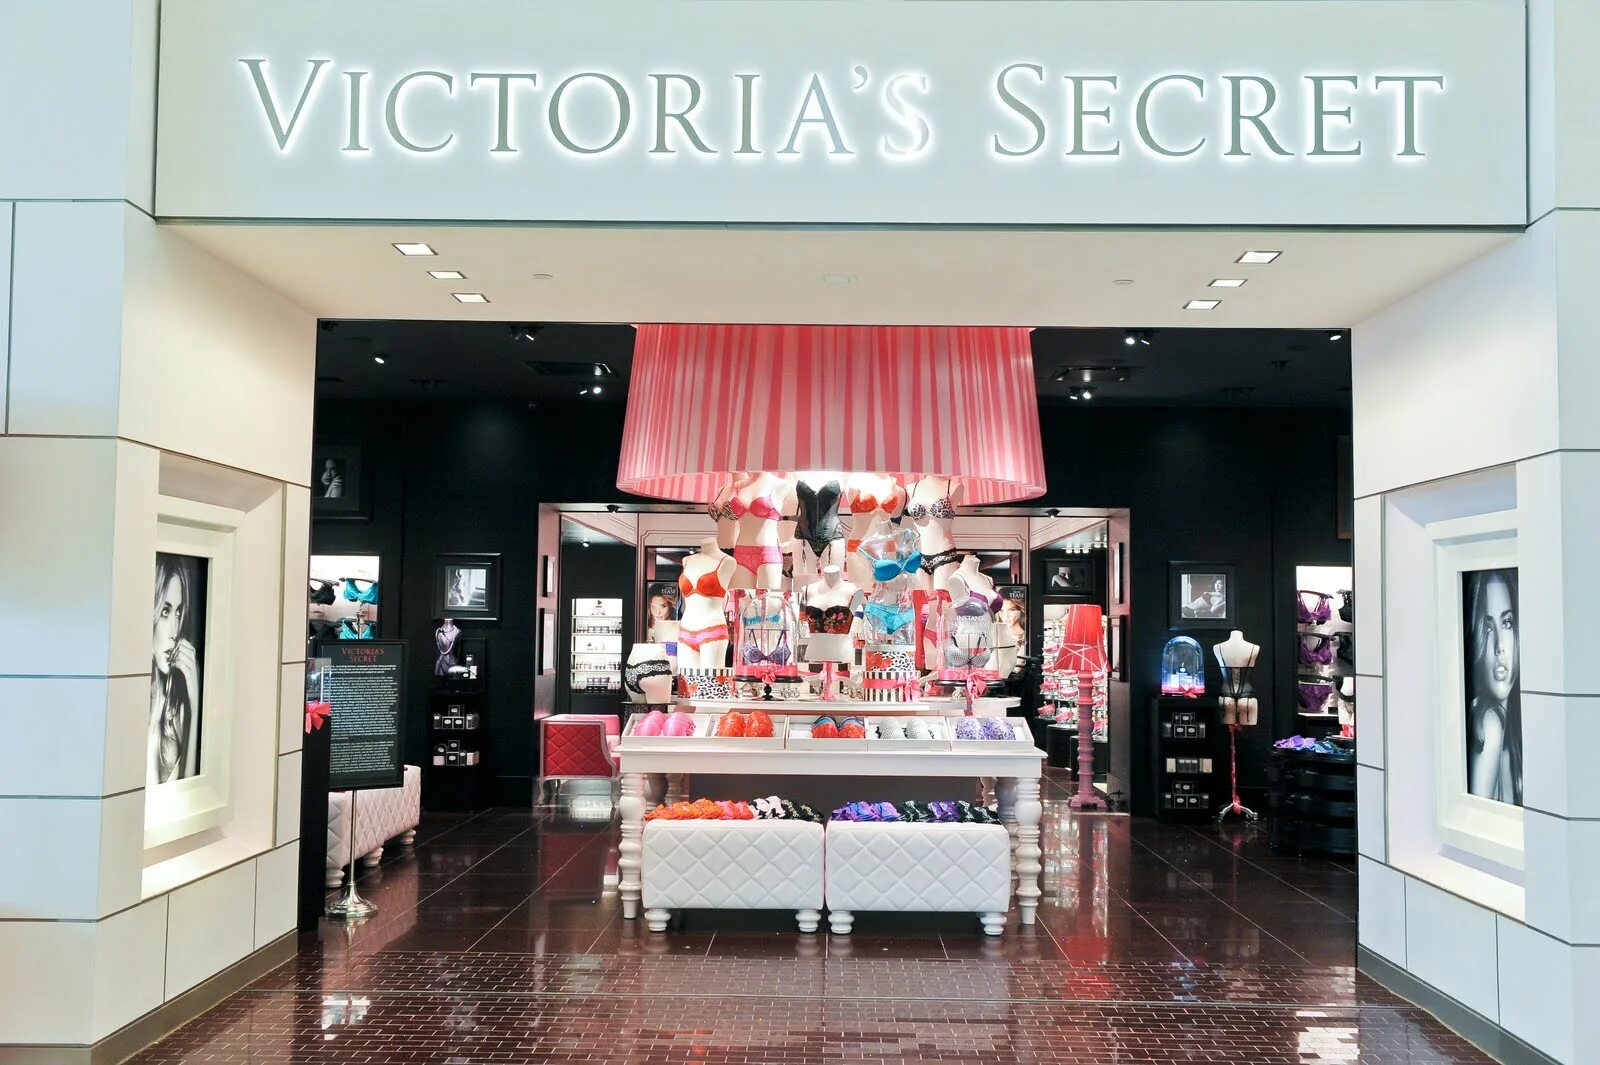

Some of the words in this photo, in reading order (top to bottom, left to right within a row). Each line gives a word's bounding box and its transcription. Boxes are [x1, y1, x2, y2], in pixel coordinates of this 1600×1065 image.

[238, 58, 931, 154] VICTORIA'S
[993, 62, 1444, 158] SECRET
[342, 648, 384, 656] VICTORIA'S
